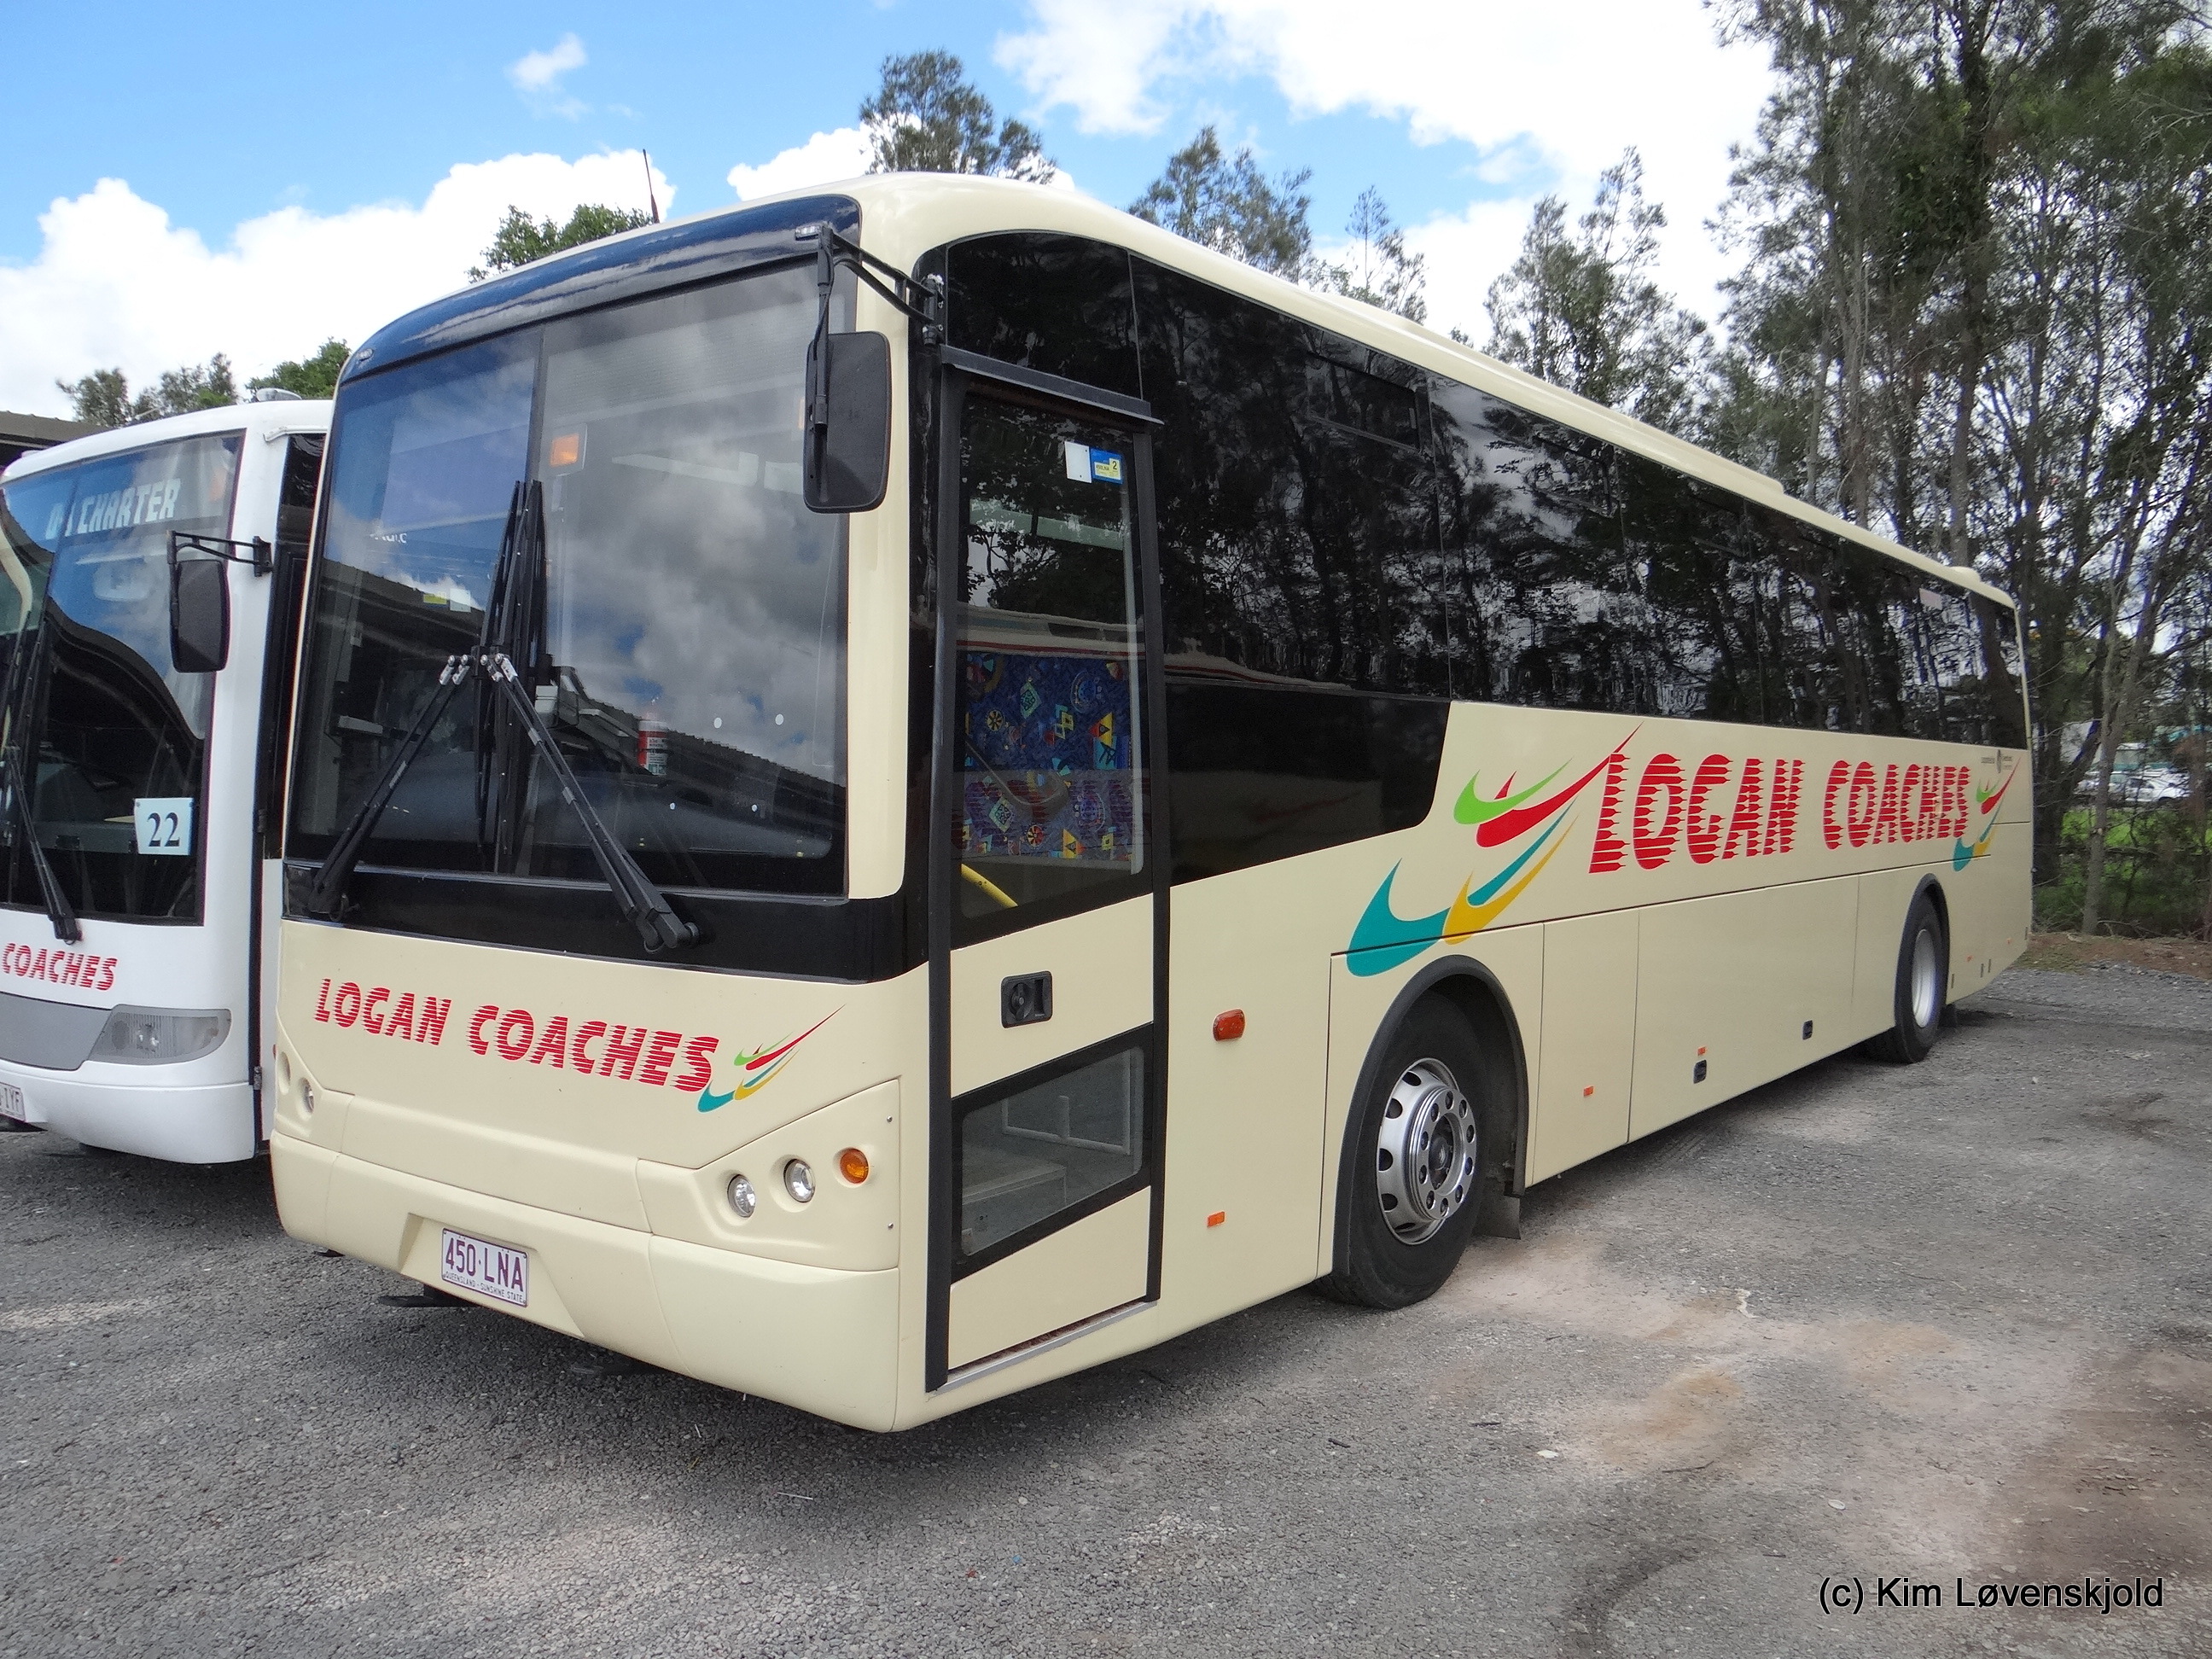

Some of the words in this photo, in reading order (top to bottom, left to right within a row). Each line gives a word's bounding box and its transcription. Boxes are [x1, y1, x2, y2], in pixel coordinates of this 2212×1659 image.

[78, 478, 181, 534] CHARTER
[147, 812, 181, 847] 22
[1589, 754, 1806, 874] LOGAN
[1822, 760, 1970, 851] COACHES
[2, 943, 118, 991] COACHES
[314, 979, 452, 1045] LOGAN
[466, 1004, 719, 1091] COACHES
[445, 1271, 476, 1288] QUEENSLAND
[480, 1282, 505, 1297] SUNSHINE
[507, 1290, 523, 1304] STATE
